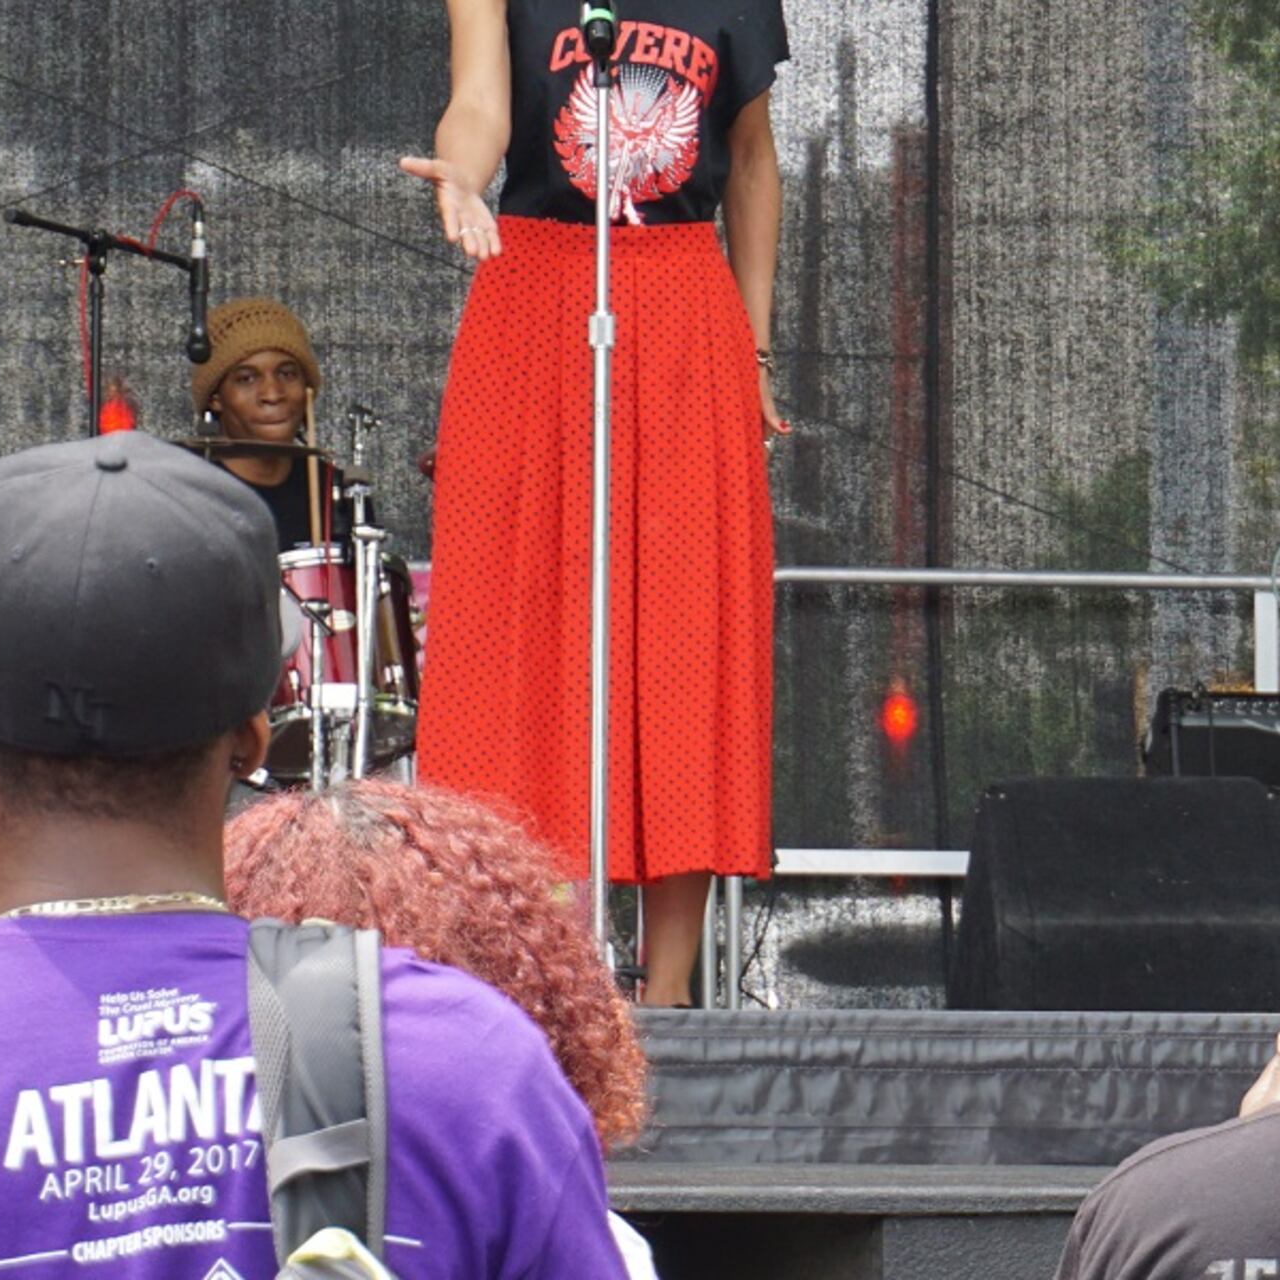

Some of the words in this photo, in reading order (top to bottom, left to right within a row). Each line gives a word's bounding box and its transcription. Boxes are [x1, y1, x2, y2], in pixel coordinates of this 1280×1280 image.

[549, 19, 719, 112] CVERE
[100, 992, 128, 1005] Help
[129, 990, 145, 1002] Us
[147, 987, 178, 1000] Solve
[98, 1002, 215, 1047] LUPUS
[3, 1057, 264, 1169] ATLANT
[39, 1164, 129, 1202] APRIL
[137, 1153, 177, 1186] 29,
[187, 1140, 260, 1178] 2017
[88, 1183, 215, 1222] LupusGA.org
